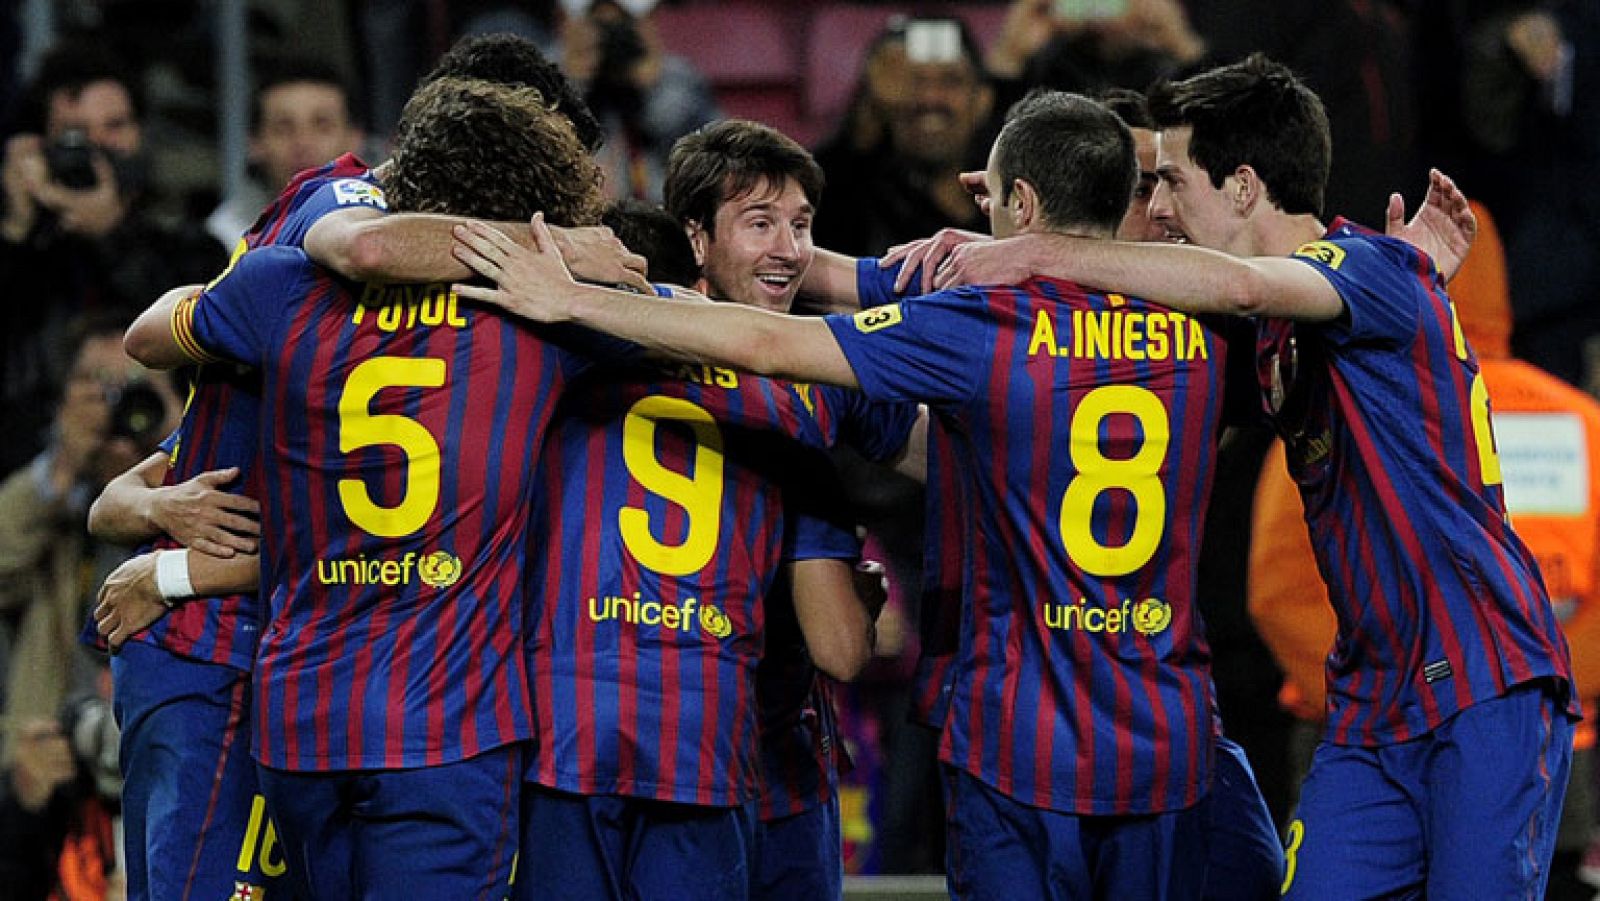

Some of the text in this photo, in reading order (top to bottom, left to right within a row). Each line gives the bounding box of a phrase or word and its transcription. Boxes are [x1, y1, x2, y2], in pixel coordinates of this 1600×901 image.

[1028, 309, 1209, 361] A.INIESTA
[337, 356, 447, 538] 5
[619, 395, 724, 577] 9
[1059, 384, 1170, 577] 8
[317, 552, 415, 586] unicef
[588, 592, 696, 632] unicef
[1044, 597, 1130, 634] unicef
